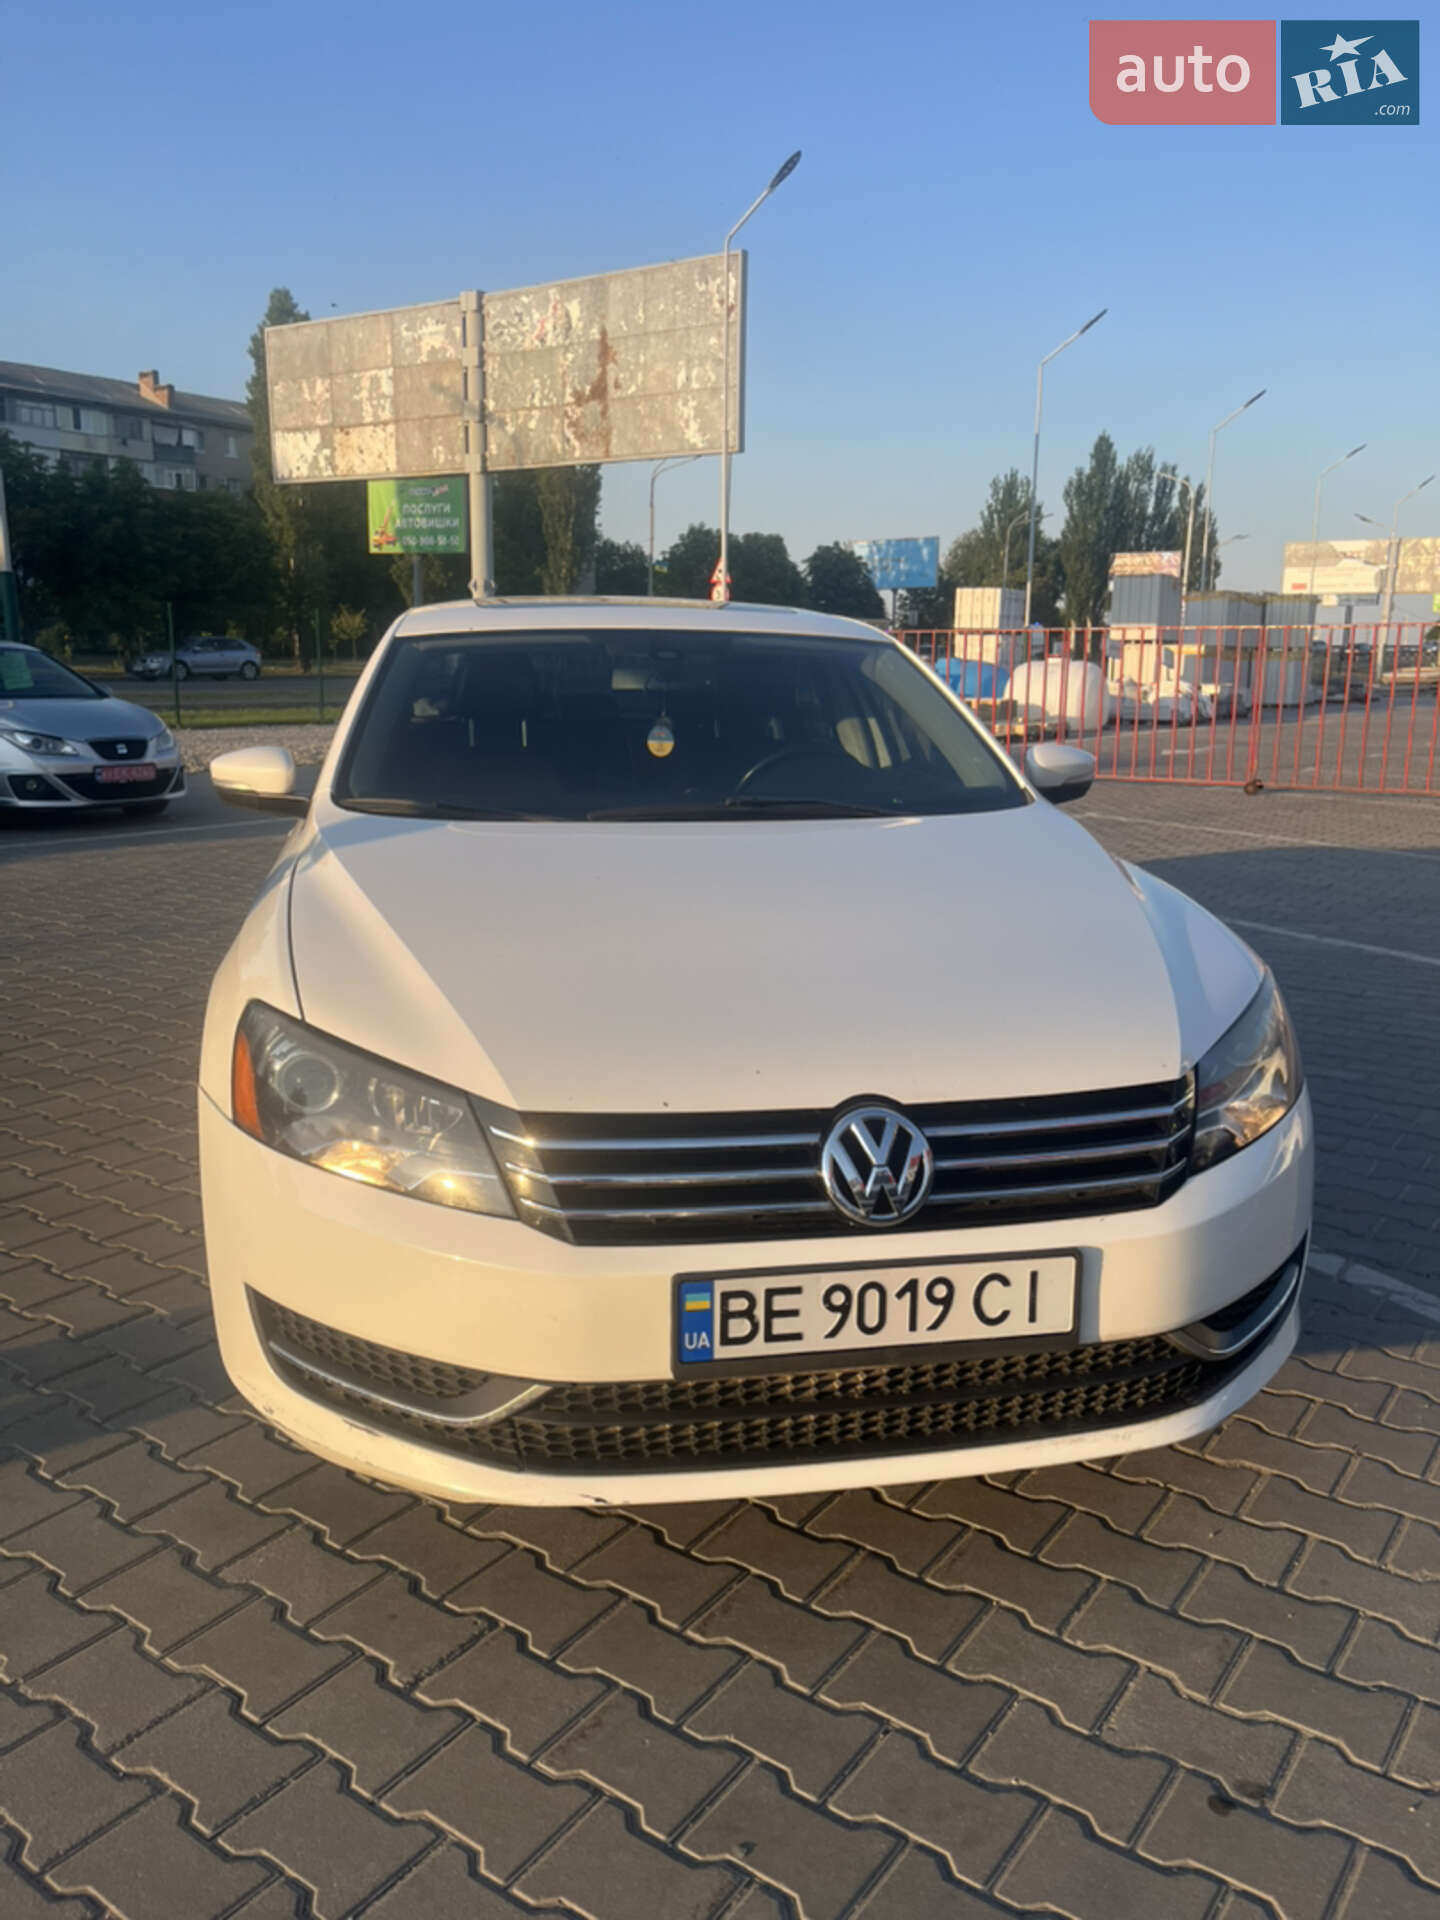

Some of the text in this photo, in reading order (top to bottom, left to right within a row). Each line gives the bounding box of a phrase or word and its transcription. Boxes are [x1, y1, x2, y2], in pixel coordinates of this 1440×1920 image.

[719, 1270, 1039, 1347] BE 9019 CI
[684, 1332, 711, 1351] UA
